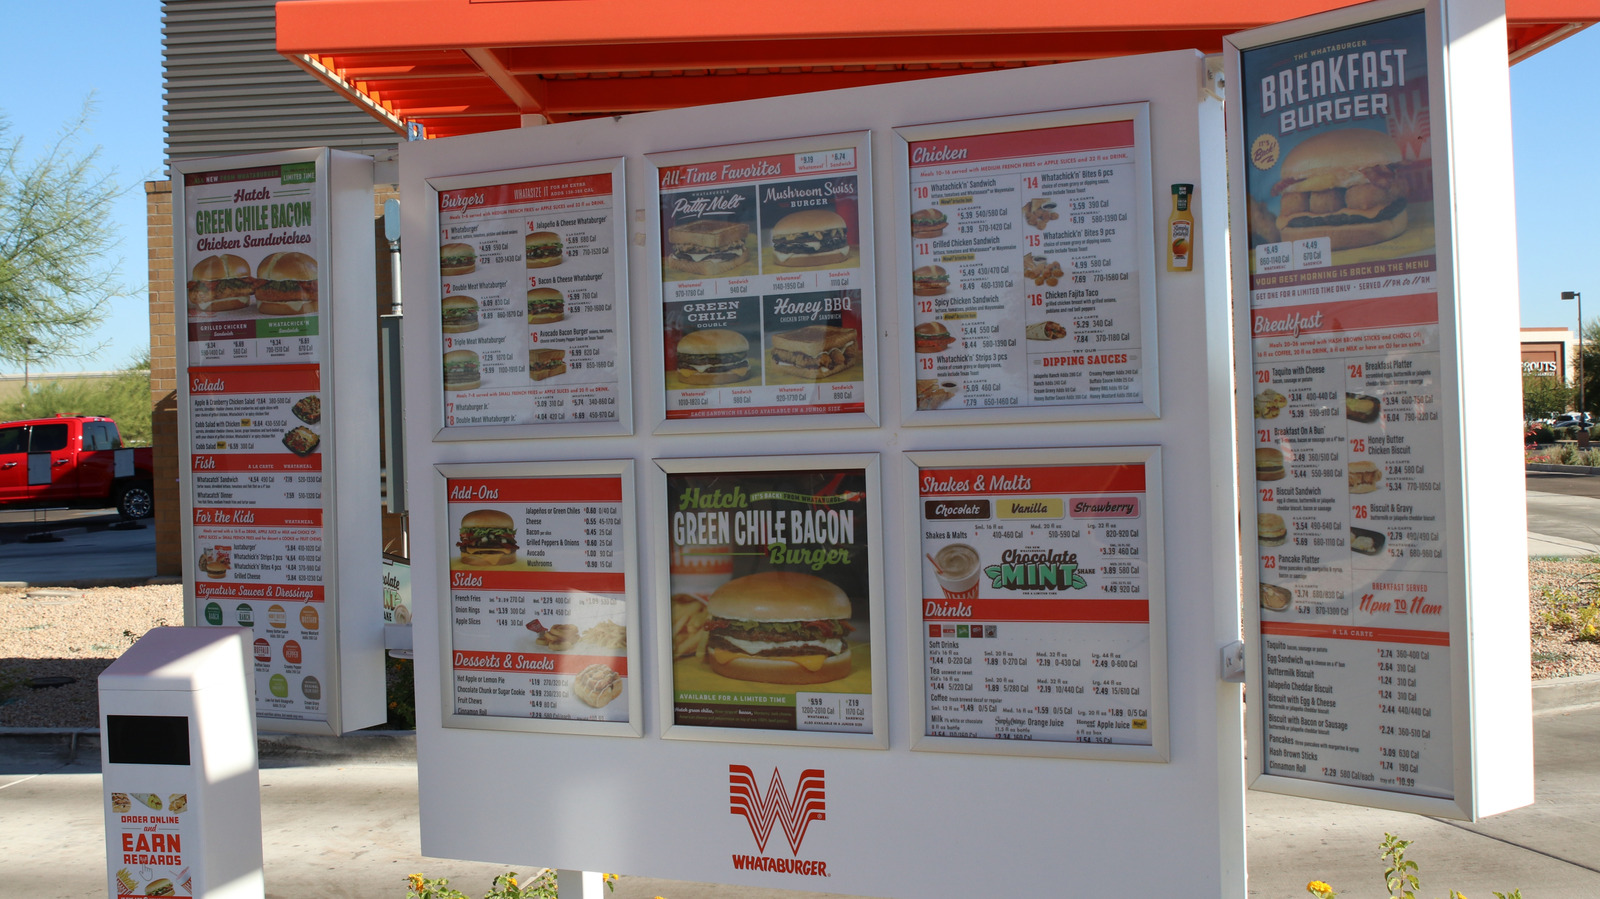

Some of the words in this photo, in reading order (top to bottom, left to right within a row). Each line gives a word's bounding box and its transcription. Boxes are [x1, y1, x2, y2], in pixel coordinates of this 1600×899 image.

[1310, 40, 1366, 56] WHATABURGER
[1262, 49, 1407, 113] BREAKFAST
[1280, 94, 1388, 133] BURGER
[913, 146, 968, 163] Chicken
[662, 168, 717, 185] All-Time
[721, 161, 781, 180] Favorites
[234, 187, 270, 203] Hatch
[514, 187, 541, 200] WHATASIZE
[544, 186, 548, 197] IT
[764, 187, 822, 203] Mushroom
[824, 182, 853, 195] Swiss
[441, 193, 484, 213] Burgers
[672, 197, 710, 218] Patty
[707, 194, 745, 212] Melt
[791, 199, 828, 208] BURGER
[196, 208, 232, 236] GREEN
[235, 204, 268, 232] CHILE
[271, 201, 311, 229] BACON
[537, 220, 555, 229] Jalapeño
[560, 218, 576, 227] Cheese
[197, 236, 240, 252] Chicken
[243, 231, 311, 248] Sandwiches
[933, 240, 950, 249] Grilled
[951, 238, 972, 247] Chicken
[973, 236, 1000, 246] Sandwich
[1256, 277, 1277, 286] YOUR
[1279, 275, 1298, 283] BEST
[1300, 271, 1337, 281] MORNING
[1340, 269, 1347, 277] IS
[1350, 266, 1372, 276] BACK
[1374, 265, 1386, 273] ON
[1388, 263, 1403, 272] THE
[1406, 260, 1429, 269] MENU
[538, 277, 552, 285] Bacon
[557, 275, 572, 283] Cheese
[1045, 290, 1067, 299] Chicken
[1069, 291, 1084, 299] Fajita
[1085, 289, 1098, 297] Taco
[684, 301, 740, 312] GREEN
[935, 298, 949, 307] Spicy
[950, 297, 971, 305] Chicken
[972, 295, 999, 303] Sandwich
[774, 298, 823, 320] Honey
[824, 297, 852, 311] BBQ
[688, 311, 737, 321] CHILE
[1254, 311, 1323, 338] Breakfast
[573, 328, 588, 336] Burger
[1043, 356, 1084, 367] DIPPING
[1088, 354, 1127, 364] SAUCES
[1521, 361, 1556, 373] ROUTS
[1272, 368, 1291, 376] Taquito
[1306, 365, 1325, 373] Cheese
[192, 378, 224, 392] Salads
[195, 456, 215, 469] Fish
[921, 477, 969, 492] Shakes
[974, 475, 985, 491] &
[989, 476, 1031, 490] Malts
[451, 485, 499, 500] Add-Ons
[680, 486, 748, 510] Hatch
[936, 504, 980, 517] Chocolate
[1012, 503, 1048, 514] Vanilla
[1074, 502, 1134, 514] Strawberry
[1370, 504, 1389, 512] Biscuit
[1391, 504, 1394, 512] &
[1397, 505, 1413, 514] Gravy
[196, 510, 211, 522] For
[215, 510, 230, 523] the
[233, 511, 254, 523] Kids
[526, 528, 539, 536] Bacon
[674, 511, 729, 545] GREEN
[735, 510, 786, 545] CHILE
[791, 510, 854, 544] BACON
[542, 539, 559, 547] Peppers
[527, 549, 545, 557] Avocado
[767, 542, 851, 570] Burger
[1002, 549, 1077, 564] Chocolate
[453, 572, 483, 587] Sides
[1002, 563, 1078, 589] MINT
[198, 584, 236, 599] Signature
[238, 586, 264, 597] Sauces
[266, 586, 272, 596] &
[275, 587, 313, 603] Dressings
[1372, 583, 1404, 591] BREAKFAST
[1406, 584, 1427, 592] SERVED
[925, 601, 971, 617] Drinks
[1359, 594, 1391, 615] 11pm
[1394, 599, 1406, 610] TO
[1410, 596, 1442, 615] 11am
[455, 653, 500, 668] Desserts
[504, 654, 512, 668] &
[516, 657, 554, 670] Snacks
[1267, 654, 1276, 664] Egg
[1278, 654, 1303, 664] Sandwich
[1267, 668, 1295, 677] Buttermilk
[1296, 669, 1314, 678] Biscuit
[1292, 682, 1313, 692] Cheddar
[1314, 684, 1332, 693] Biscuit
[931, 694, 948, 702] Coffee
[1269, 734, 1293, 745] Pancakes
[1269, 748, 1282, 756] Hash
[1284, 749, 1300, 759] Brown
[1302, 749, 1317, 760] Sticks
[1270, 761, 1295, 771] Cinnamon
[1296, 763, 1306, 772] Roll
[122, 833, 180, 852] EARN
[124, 854, 181, 865] REWARDS
[732, 854, 827, 877] WHATABURGER
